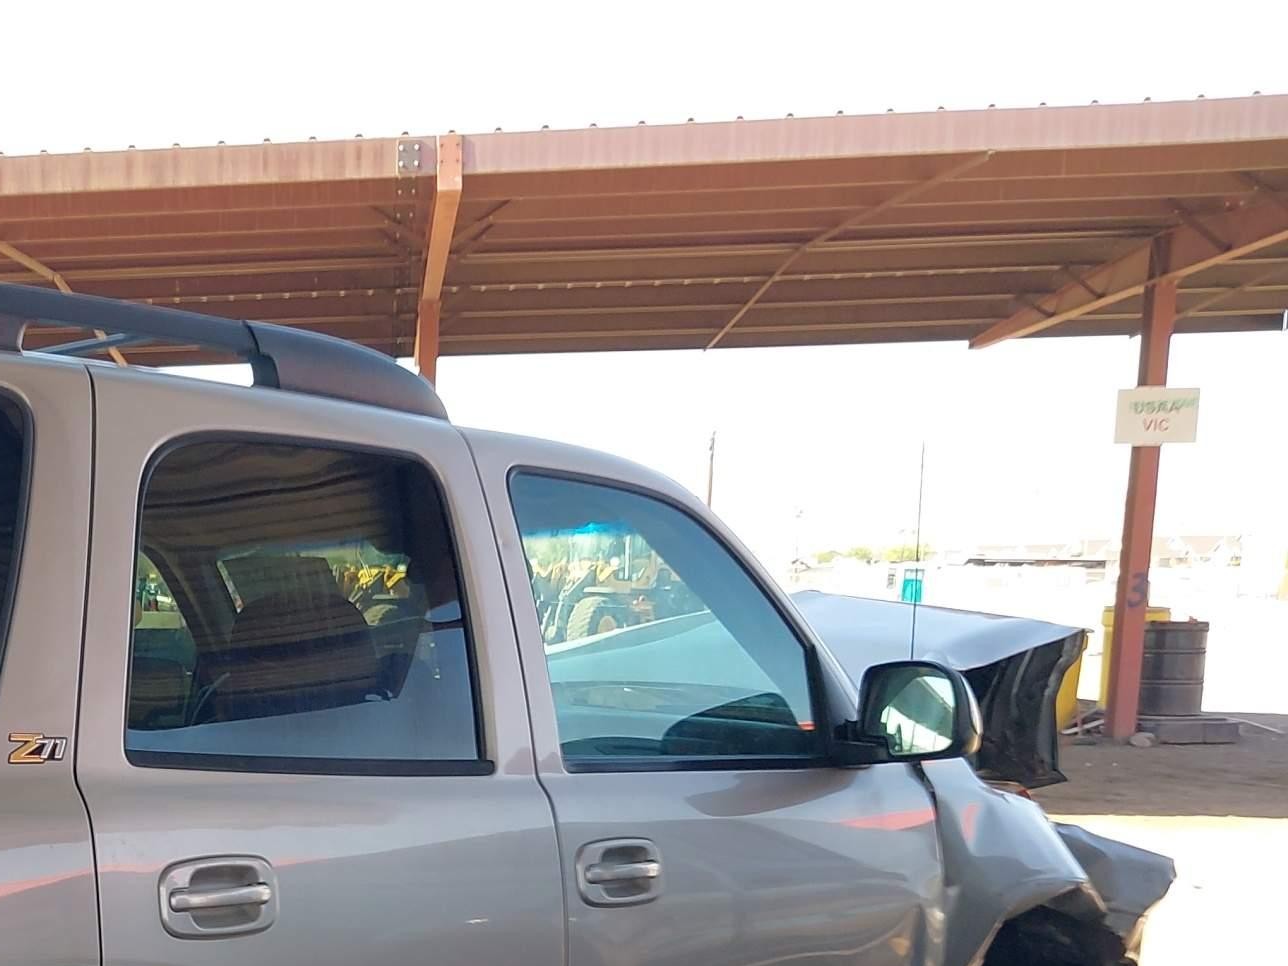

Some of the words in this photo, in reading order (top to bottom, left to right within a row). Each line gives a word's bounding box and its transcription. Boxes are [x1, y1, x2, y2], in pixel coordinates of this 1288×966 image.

[1143, 418, 1170, 432] VIC
[1127, 572, 1149, 608] 3
[8, 733, 67, 764] Z71
